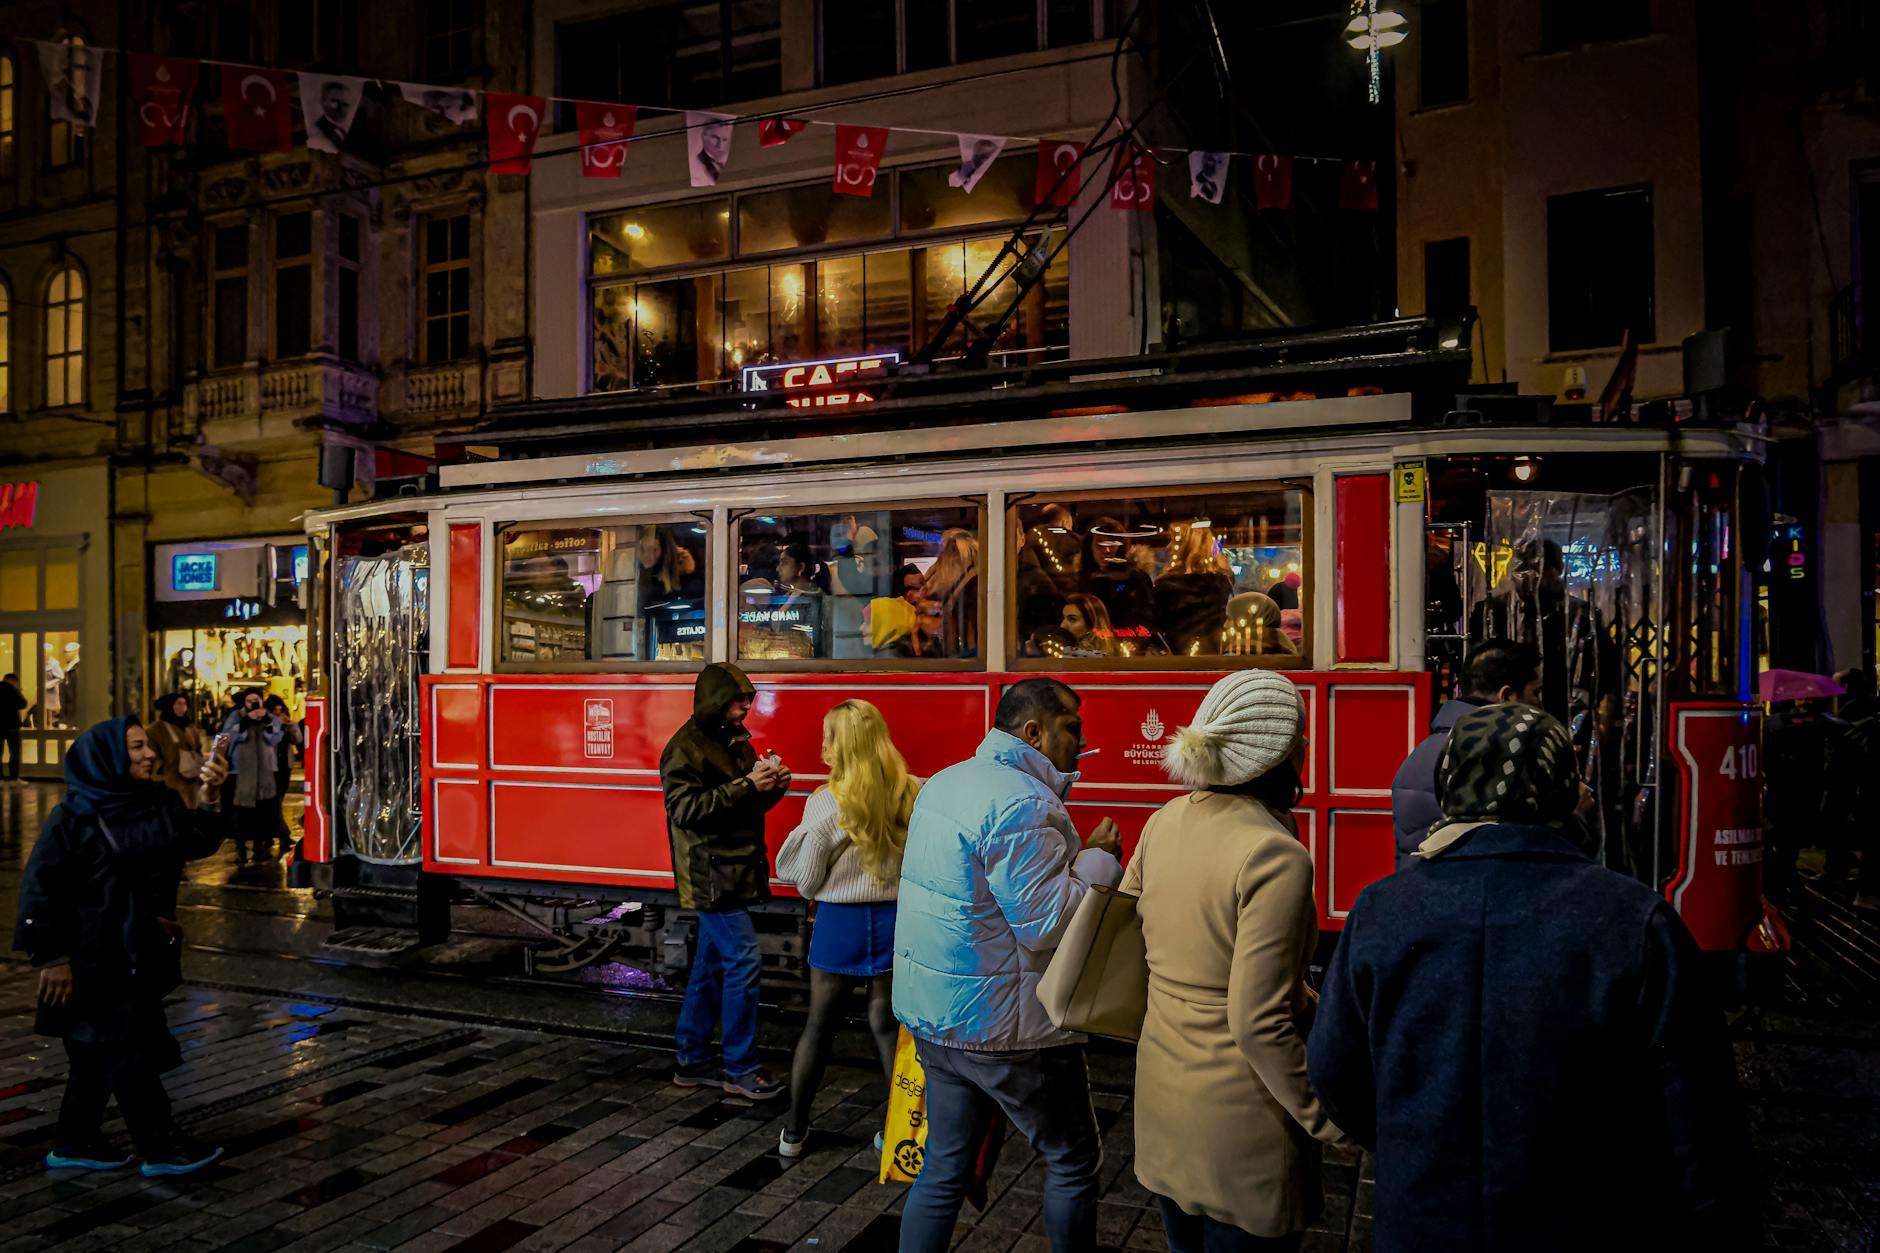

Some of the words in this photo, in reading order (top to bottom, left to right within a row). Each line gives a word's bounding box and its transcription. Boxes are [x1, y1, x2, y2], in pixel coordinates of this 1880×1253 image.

[1787, 527, 1806, 579] KIDS
[178, 573, 212, 584] JONES
[1719, 744, 1758, 780] 410
